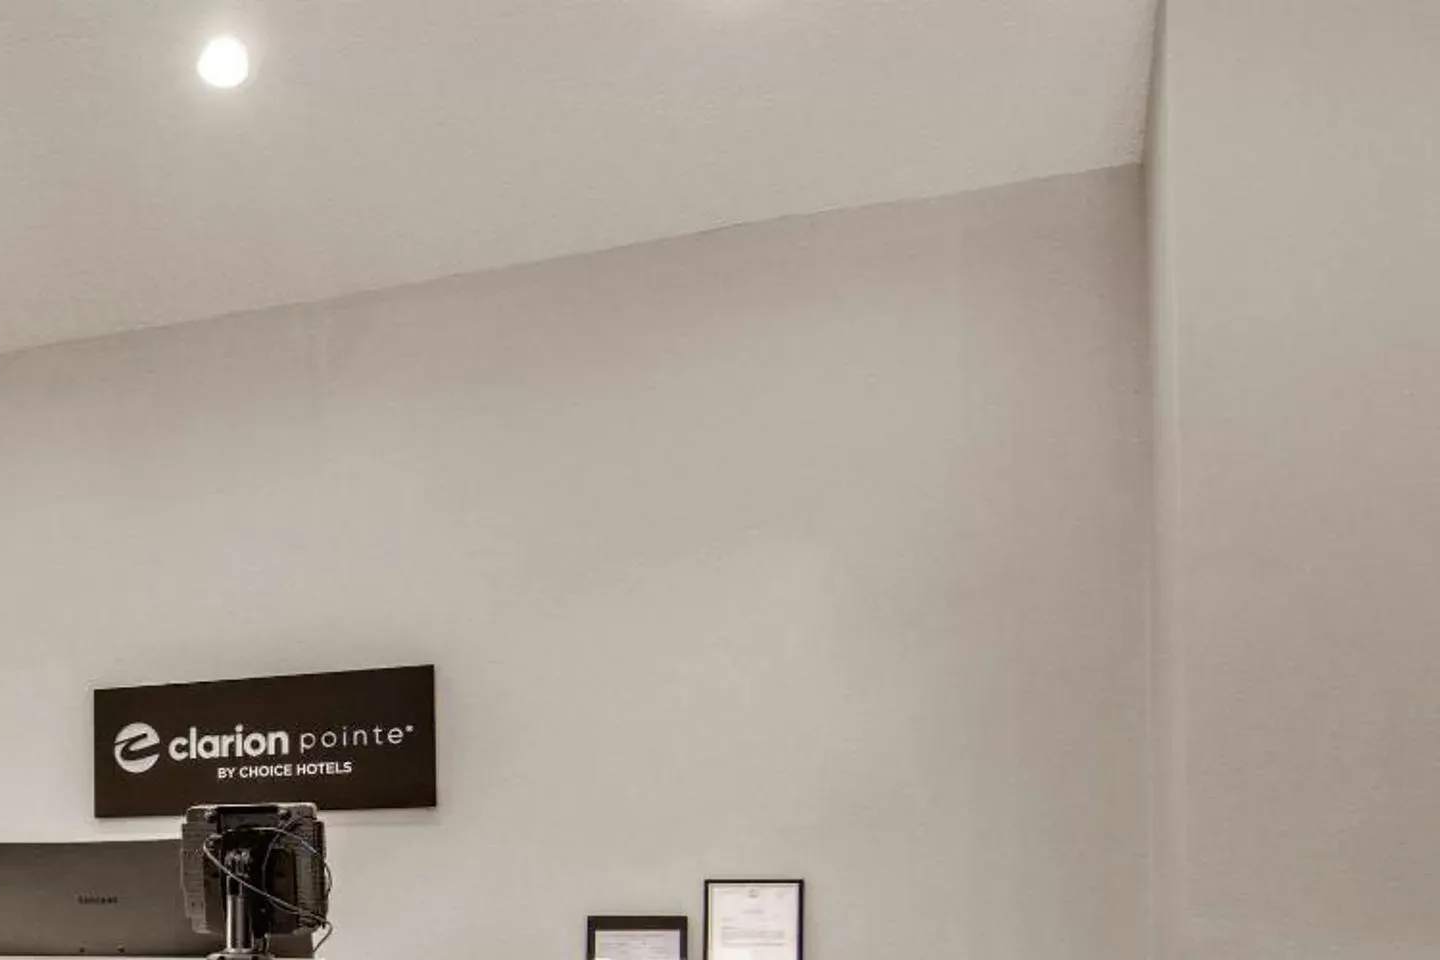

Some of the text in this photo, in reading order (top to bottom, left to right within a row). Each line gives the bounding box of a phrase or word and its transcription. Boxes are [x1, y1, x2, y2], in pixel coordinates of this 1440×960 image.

[168, 724, 289, 762] clarion
[217, 761, 353, 779] BY CHOICE HOTELS
